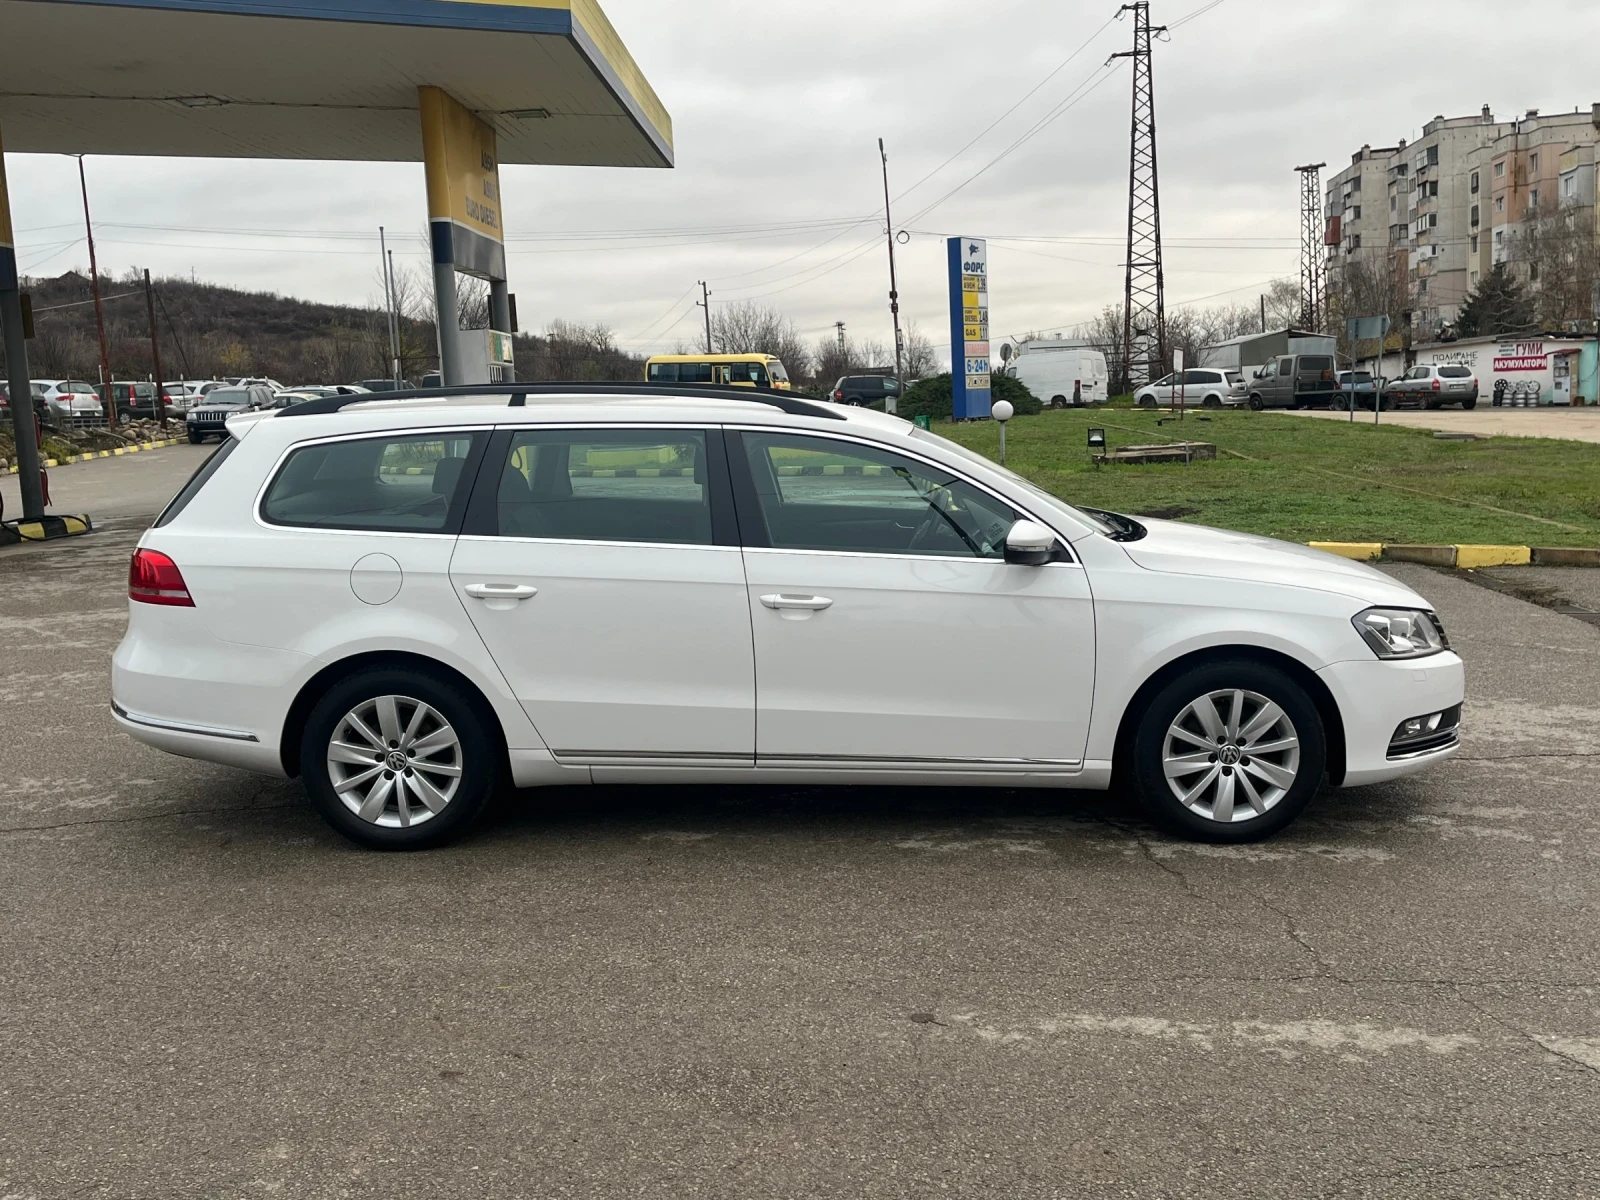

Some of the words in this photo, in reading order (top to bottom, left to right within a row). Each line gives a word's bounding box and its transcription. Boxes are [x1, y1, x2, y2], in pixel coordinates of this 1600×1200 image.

[963, 261, 985, 273] ФОРС
[964, 314, 979, 323] DIESEL
[965, 328, 977, 337] GAS
[1516, 342, 1543, 356] ГУМИ
[1432, 350, 1478, 362] ПОЛИРАНЕ
[1494, 358, 1547, 369] АКУМУЛАТОРИ
